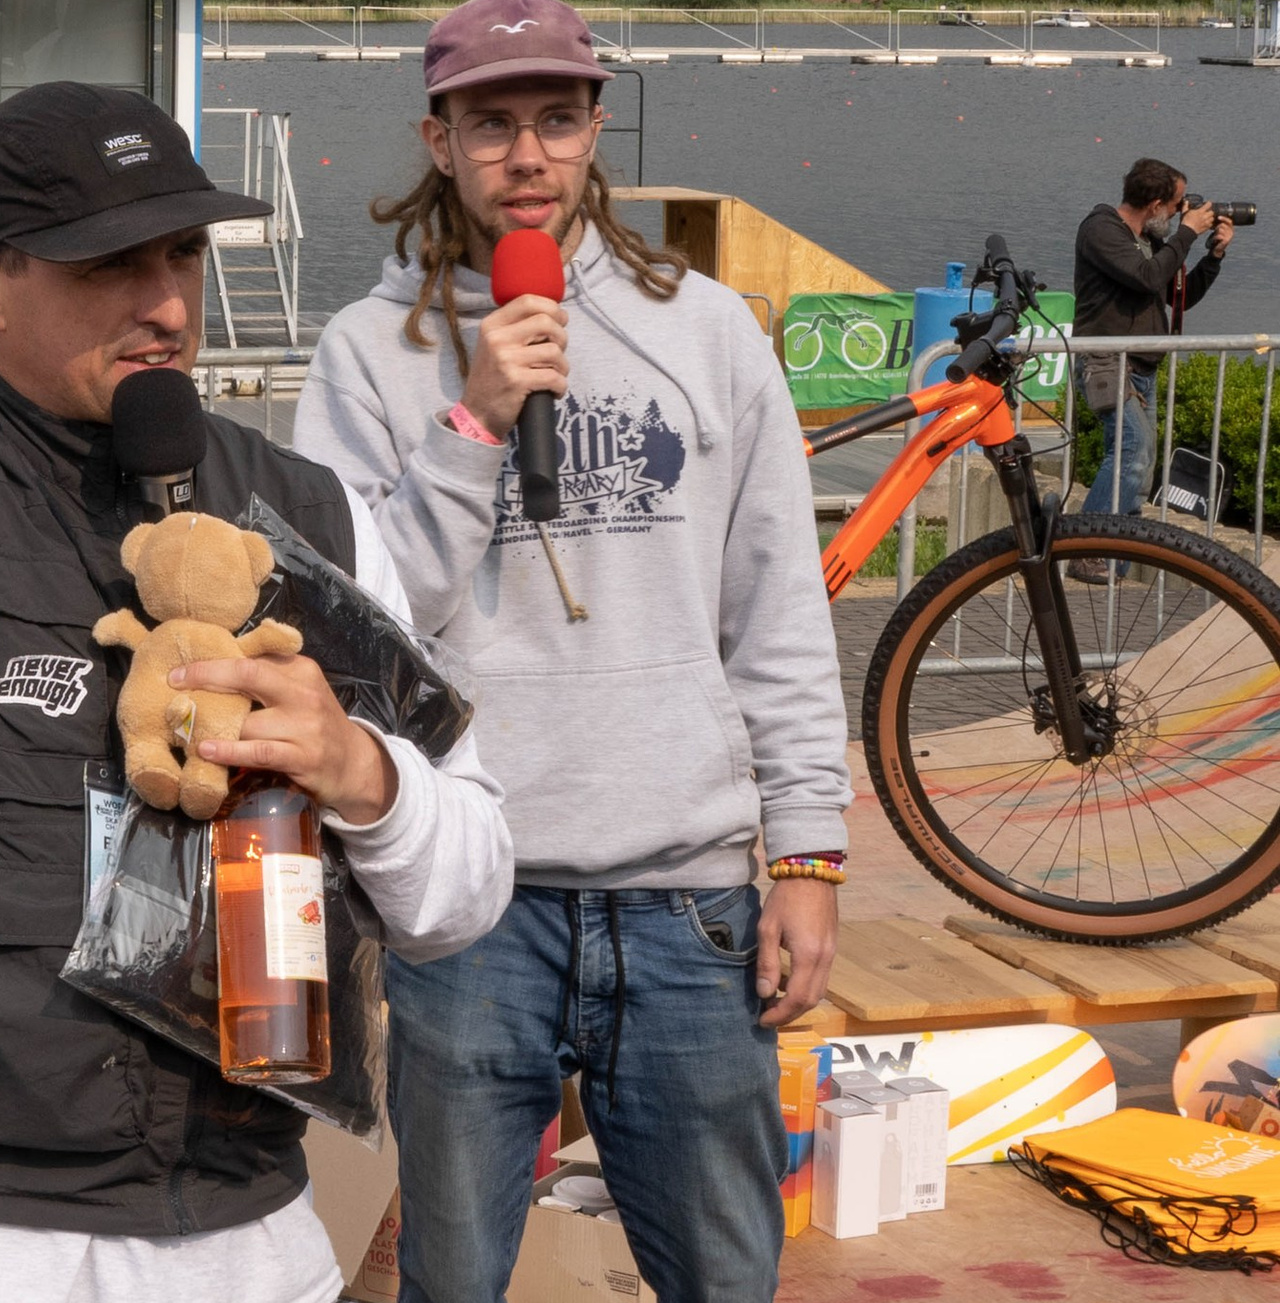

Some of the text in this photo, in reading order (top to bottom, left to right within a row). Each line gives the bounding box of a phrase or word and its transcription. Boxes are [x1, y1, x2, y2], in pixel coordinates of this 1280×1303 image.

[606, 525, 653, 534] GERMANY
[7, 657, 89, 682] never
[889, 757, 966, 876] SCHWALBE
